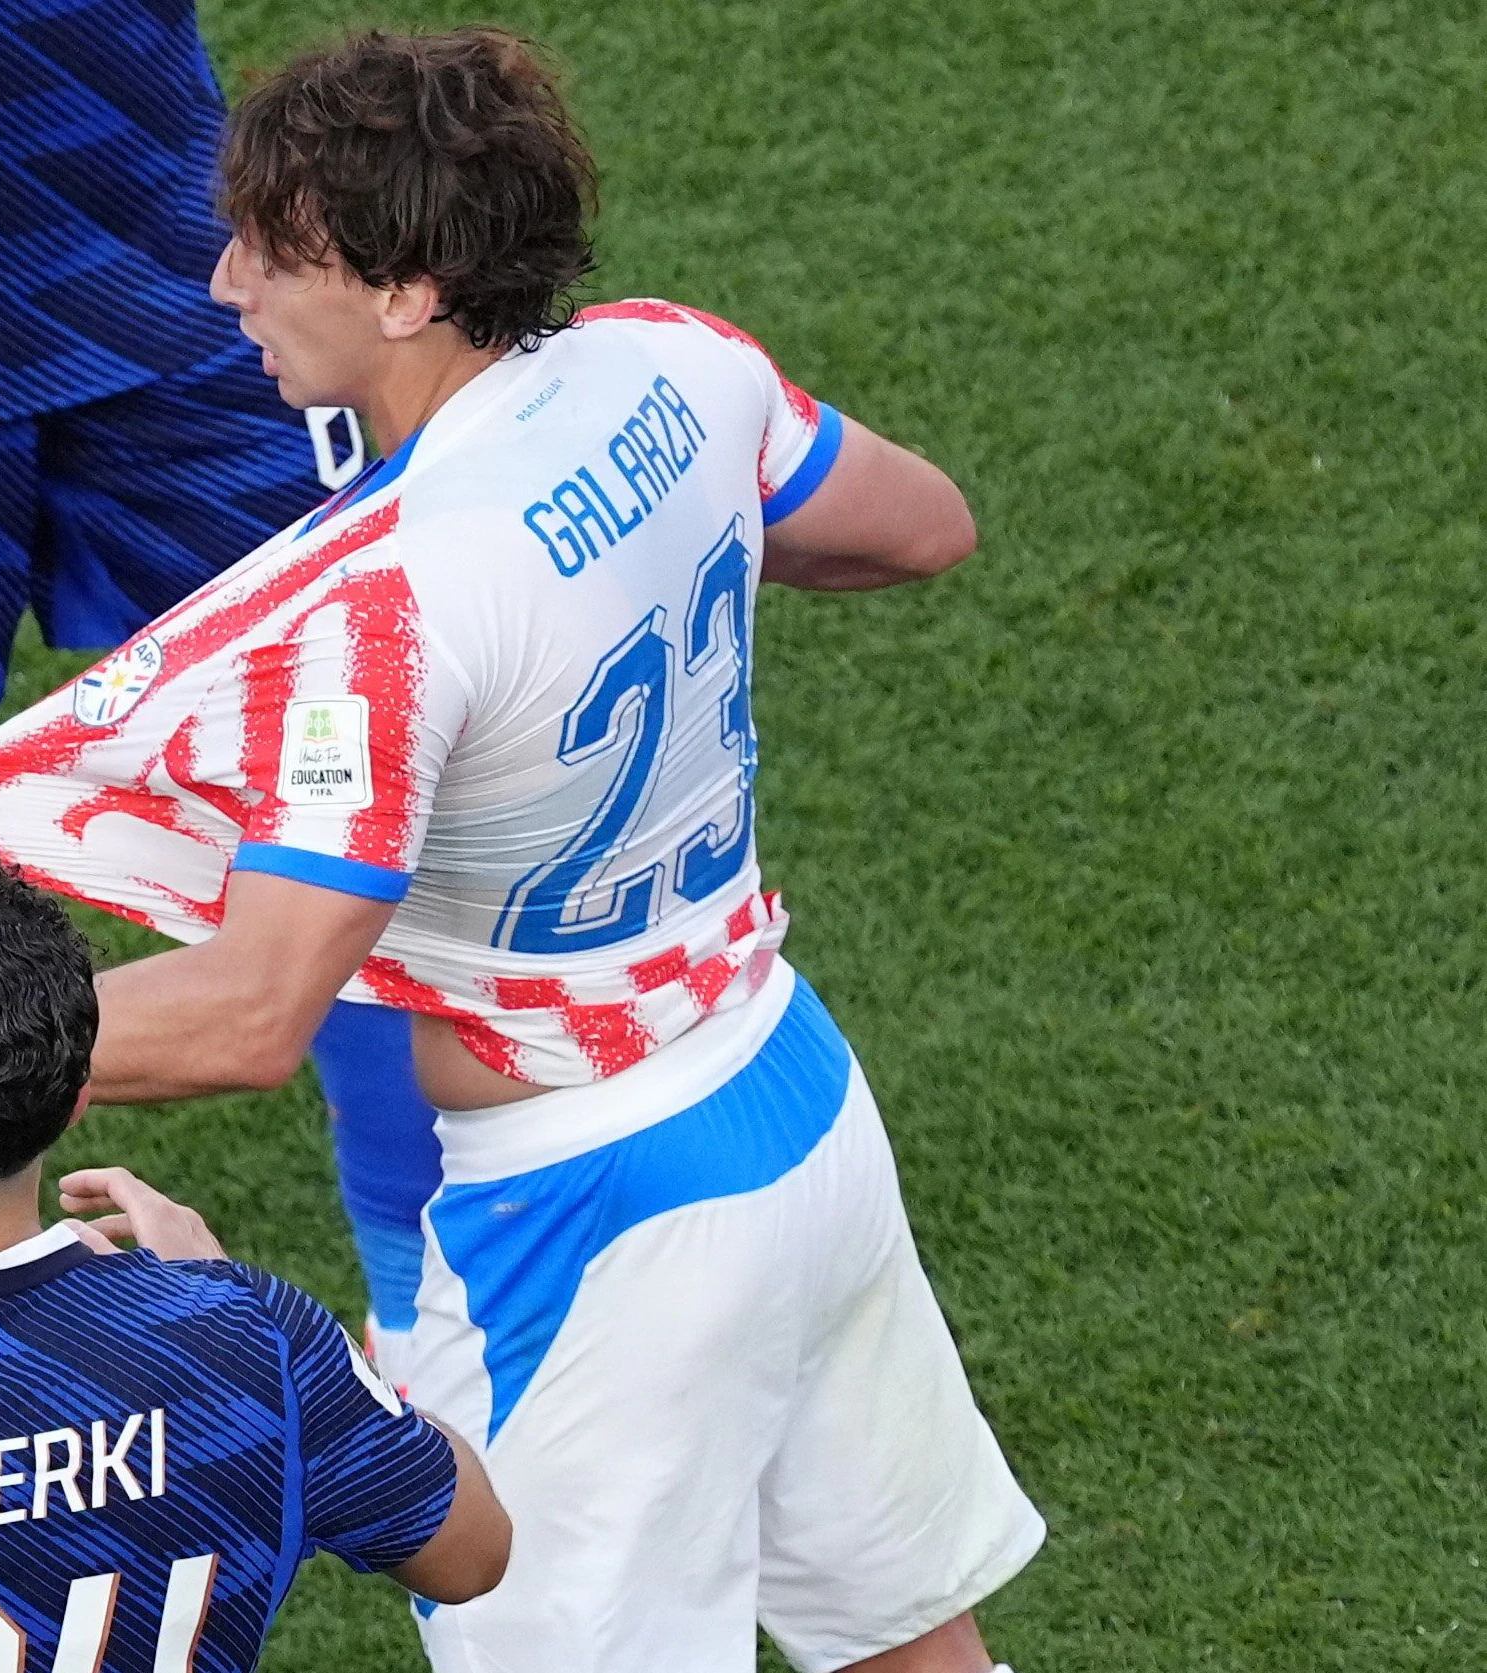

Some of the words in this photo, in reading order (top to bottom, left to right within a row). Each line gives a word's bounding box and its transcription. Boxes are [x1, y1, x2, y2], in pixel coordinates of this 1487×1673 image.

[515, 376, 566, 422] PARAGUAY
[522, 374, 707, 578] GALARZA
[490, 511, 758, 954] 23
[291, 768, 353, 786] EDUCATION
[310, 788, 334, 797] FIFA
